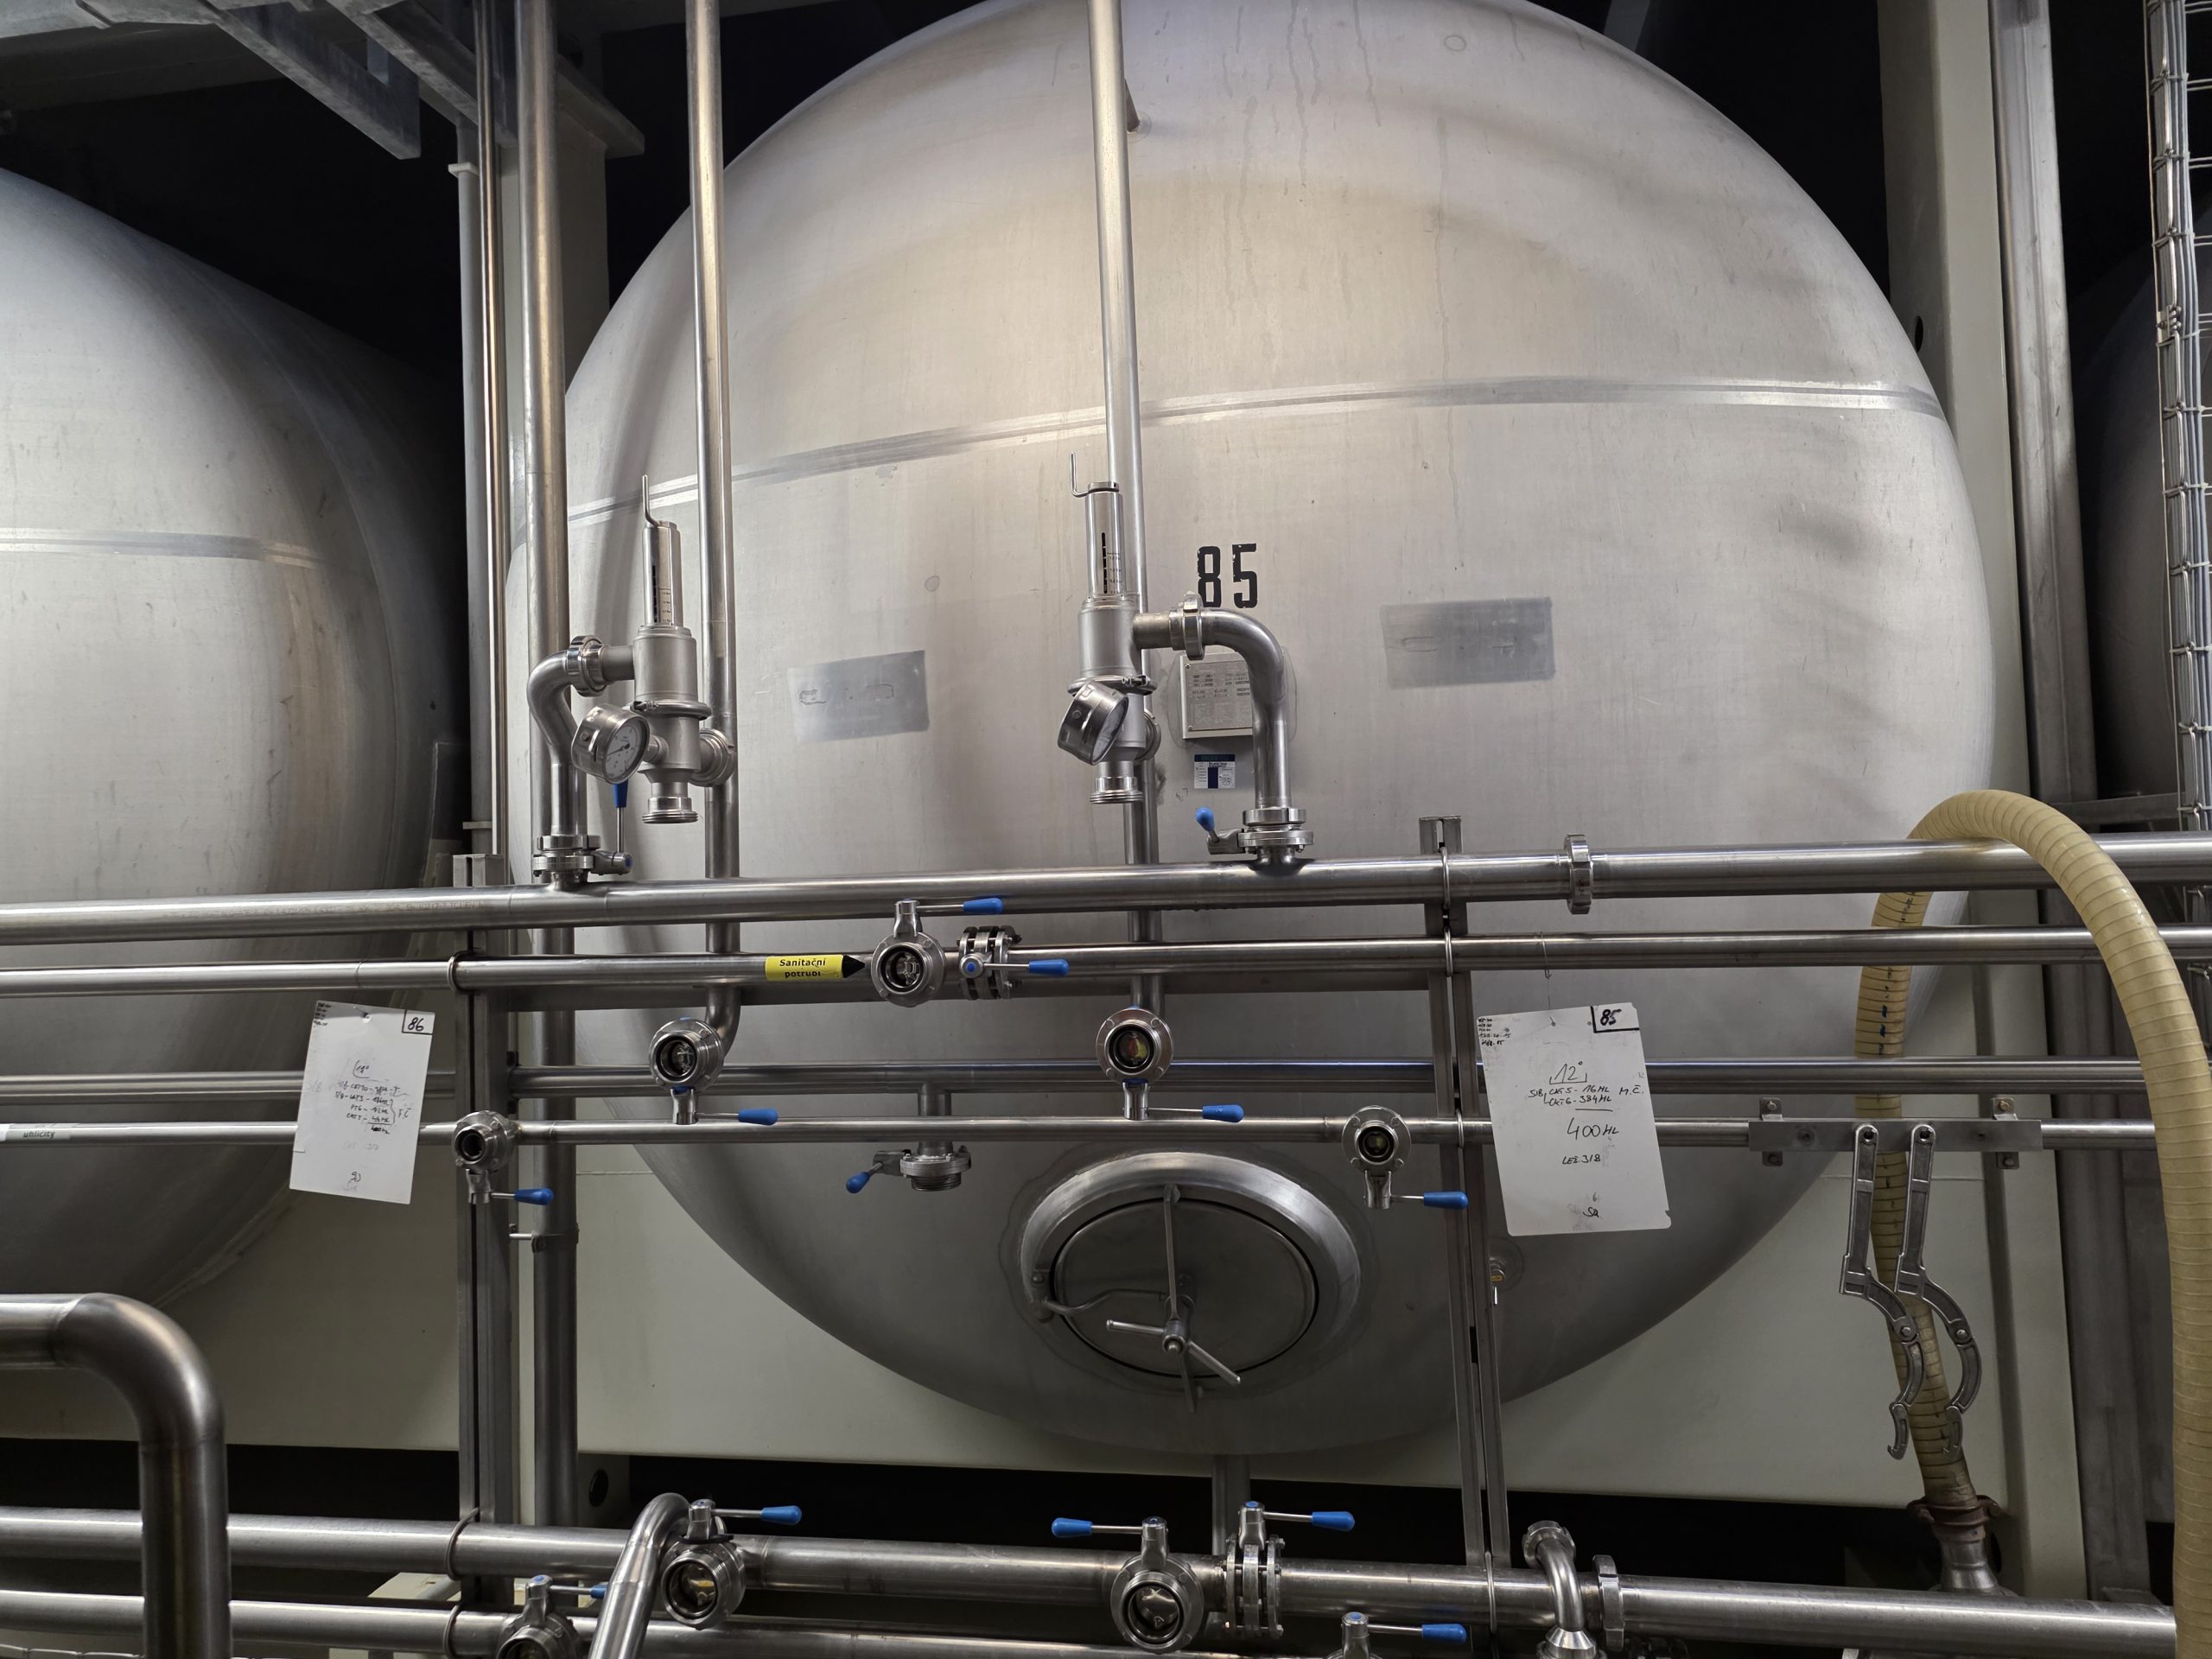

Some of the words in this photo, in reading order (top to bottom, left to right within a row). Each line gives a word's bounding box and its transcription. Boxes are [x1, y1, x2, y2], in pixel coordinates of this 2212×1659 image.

[1197, 543, 1258, 608] 85
[408, 1017, 424, 1031] 86
[1600, 1008, 1622, 1026] 85
